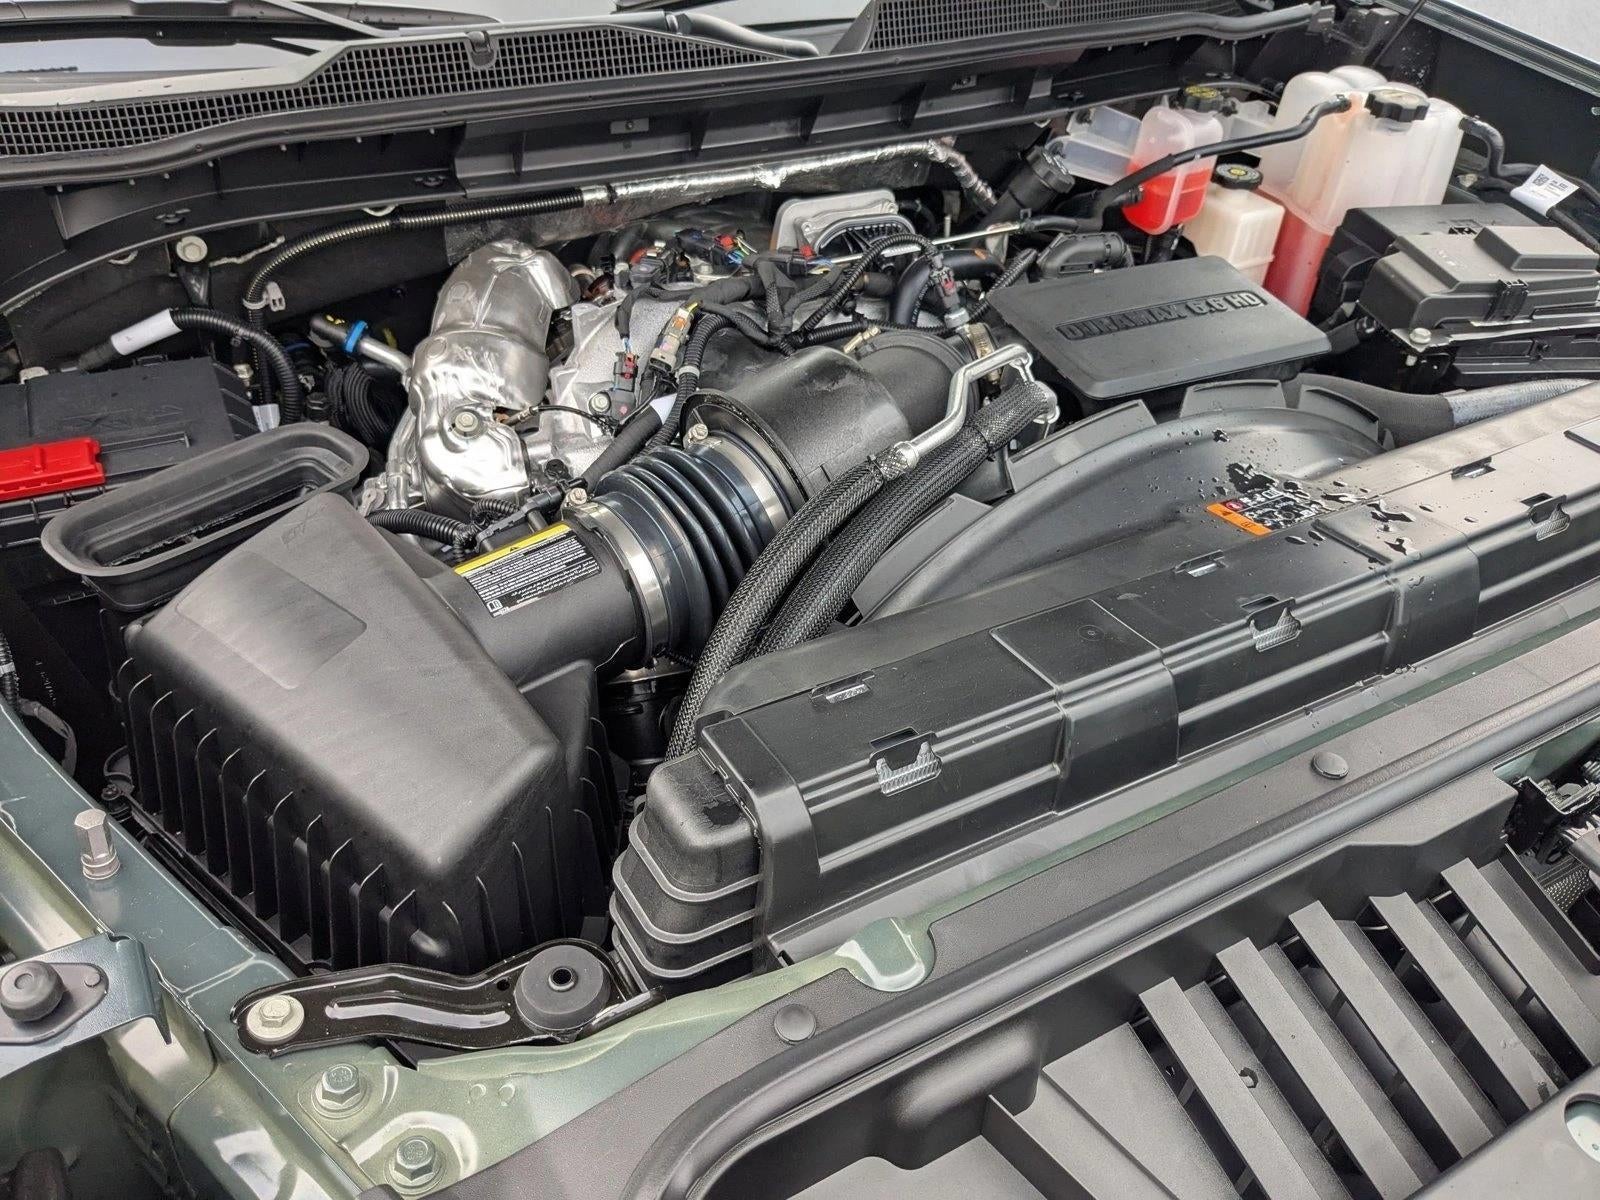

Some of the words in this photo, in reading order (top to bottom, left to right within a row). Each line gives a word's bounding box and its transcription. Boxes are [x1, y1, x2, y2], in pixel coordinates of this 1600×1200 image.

[1058, 305, 1187, 339] DURAMAX
[1186, 297, 1228, 315] 6.6
[1226, 292, 1262, 309] HD
